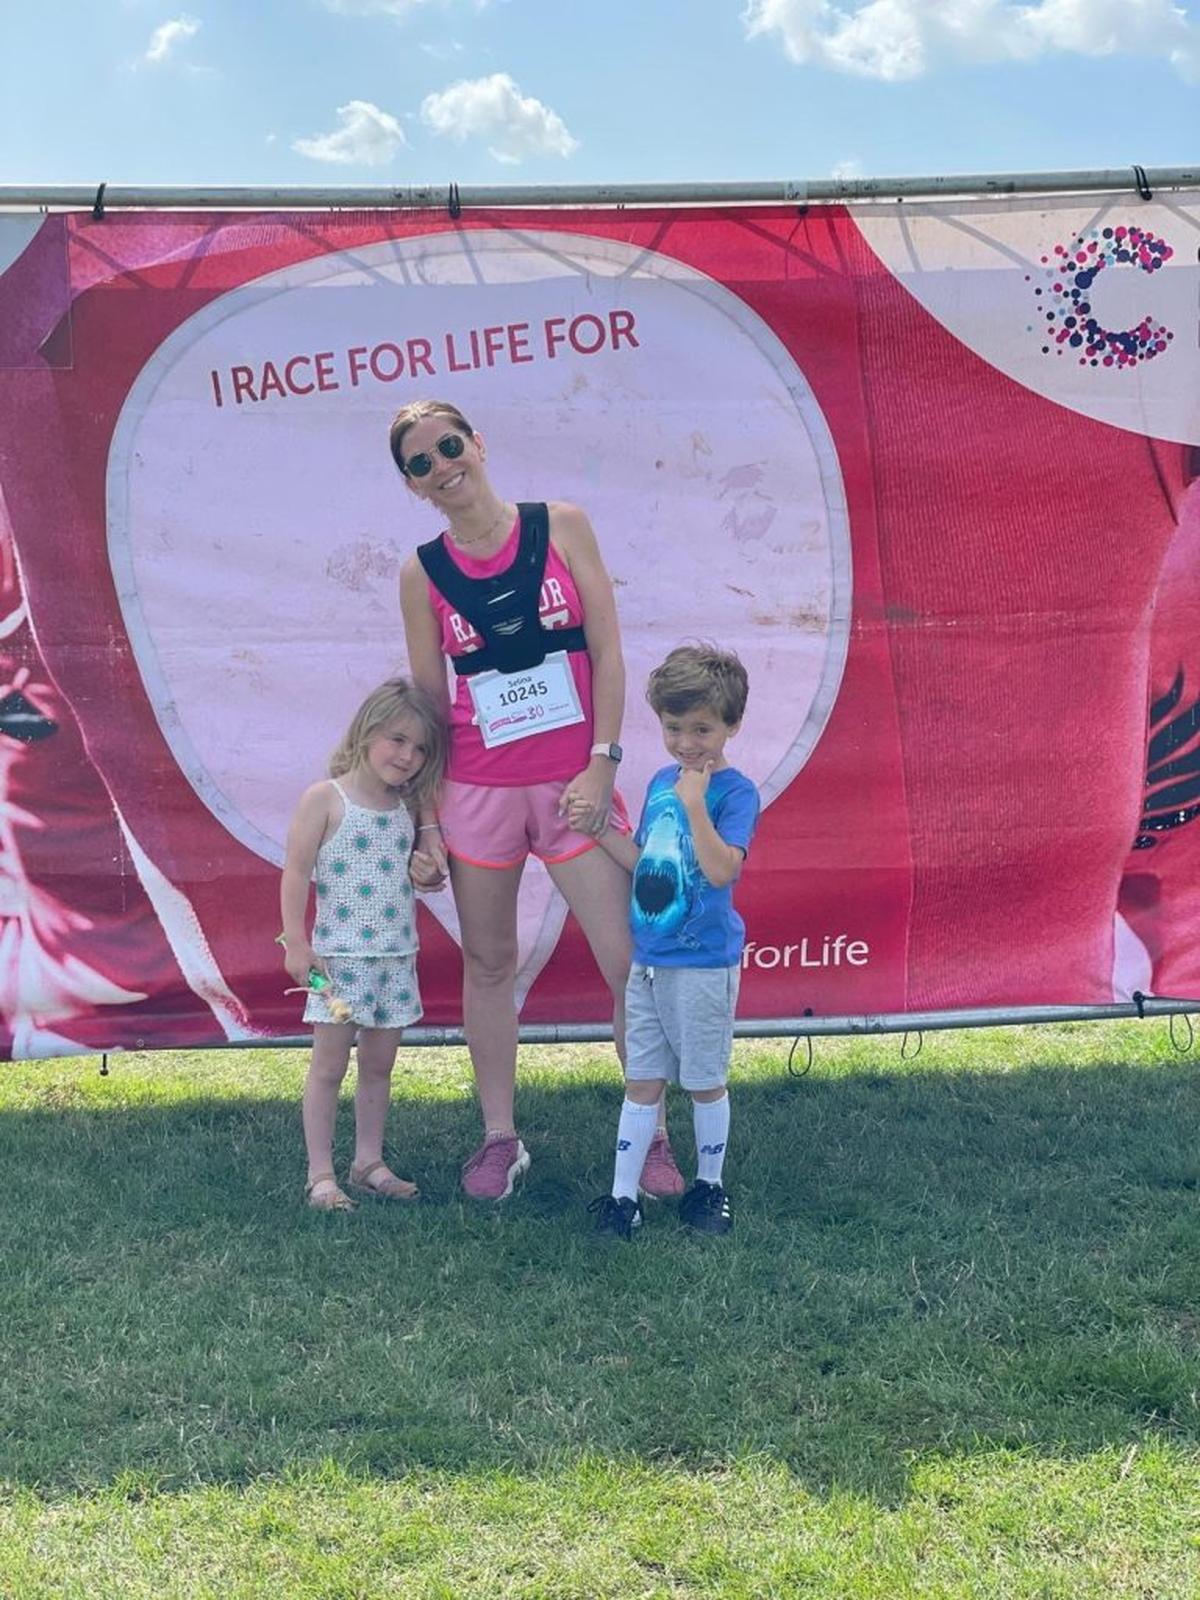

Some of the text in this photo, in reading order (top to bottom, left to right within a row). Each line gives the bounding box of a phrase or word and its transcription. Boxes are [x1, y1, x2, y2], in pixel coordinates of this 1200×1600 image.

[211, 310, 639, 407] I RACE FOR LIFE FOR
[500, 681, 548, 706] 10245
